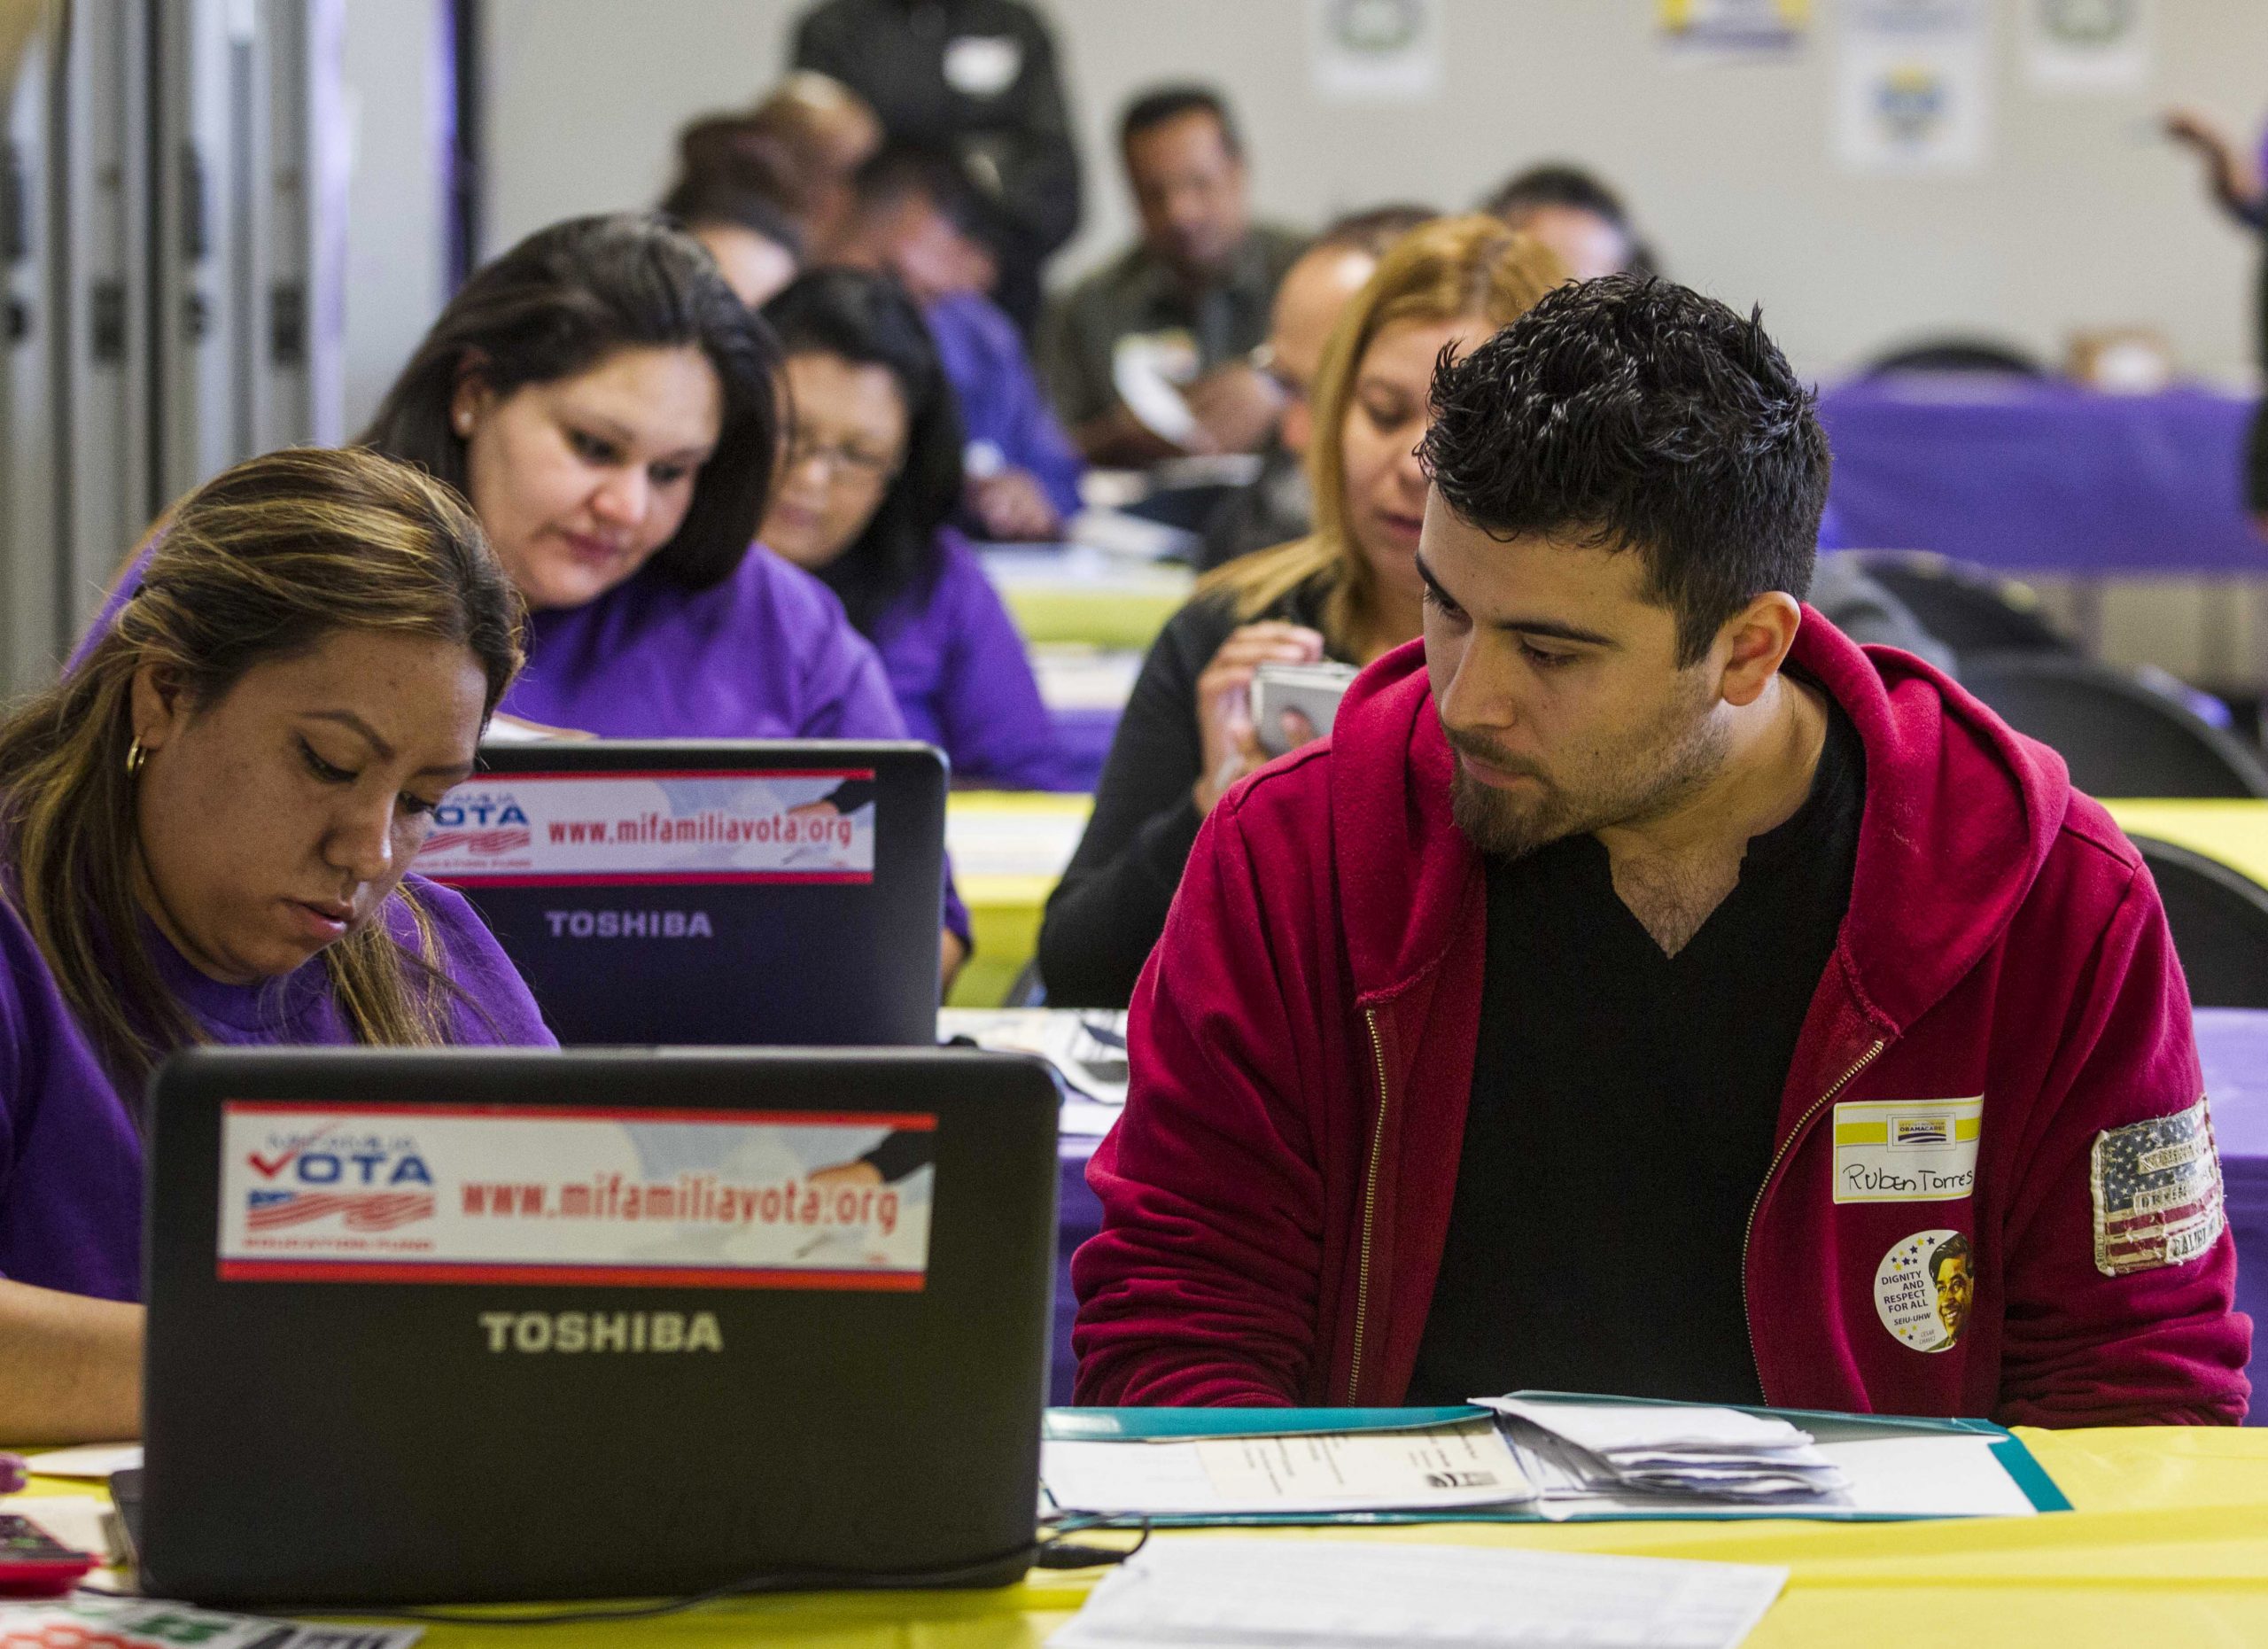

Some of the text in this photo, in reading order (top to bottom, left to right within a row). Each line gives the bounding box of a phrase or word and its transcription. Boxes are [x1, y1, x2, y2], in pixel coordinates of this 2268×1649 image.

[433, 804, 529, 827] OTA
[548, 812, 852, 848] www.mifamiliavota.org
[545, 910, 712, 937] TOSHIBA
[1918, 1170, 1973, 1191] Torres
[460, 1173, 898, 1236] www.mifamiliavota.org
[1881, 1271, 1922, 1285] DIGNITY
[1903, 1280, 1924, 1291] AND
[1884, 1289, 1925, 1304] RESPECT
[1888, 1299, 1928, 1313] FOR ALL
[1894, 1312, 1931, 1326] SEIU-UHW
[478, 1311, 724, 1352] TOSHIBA
